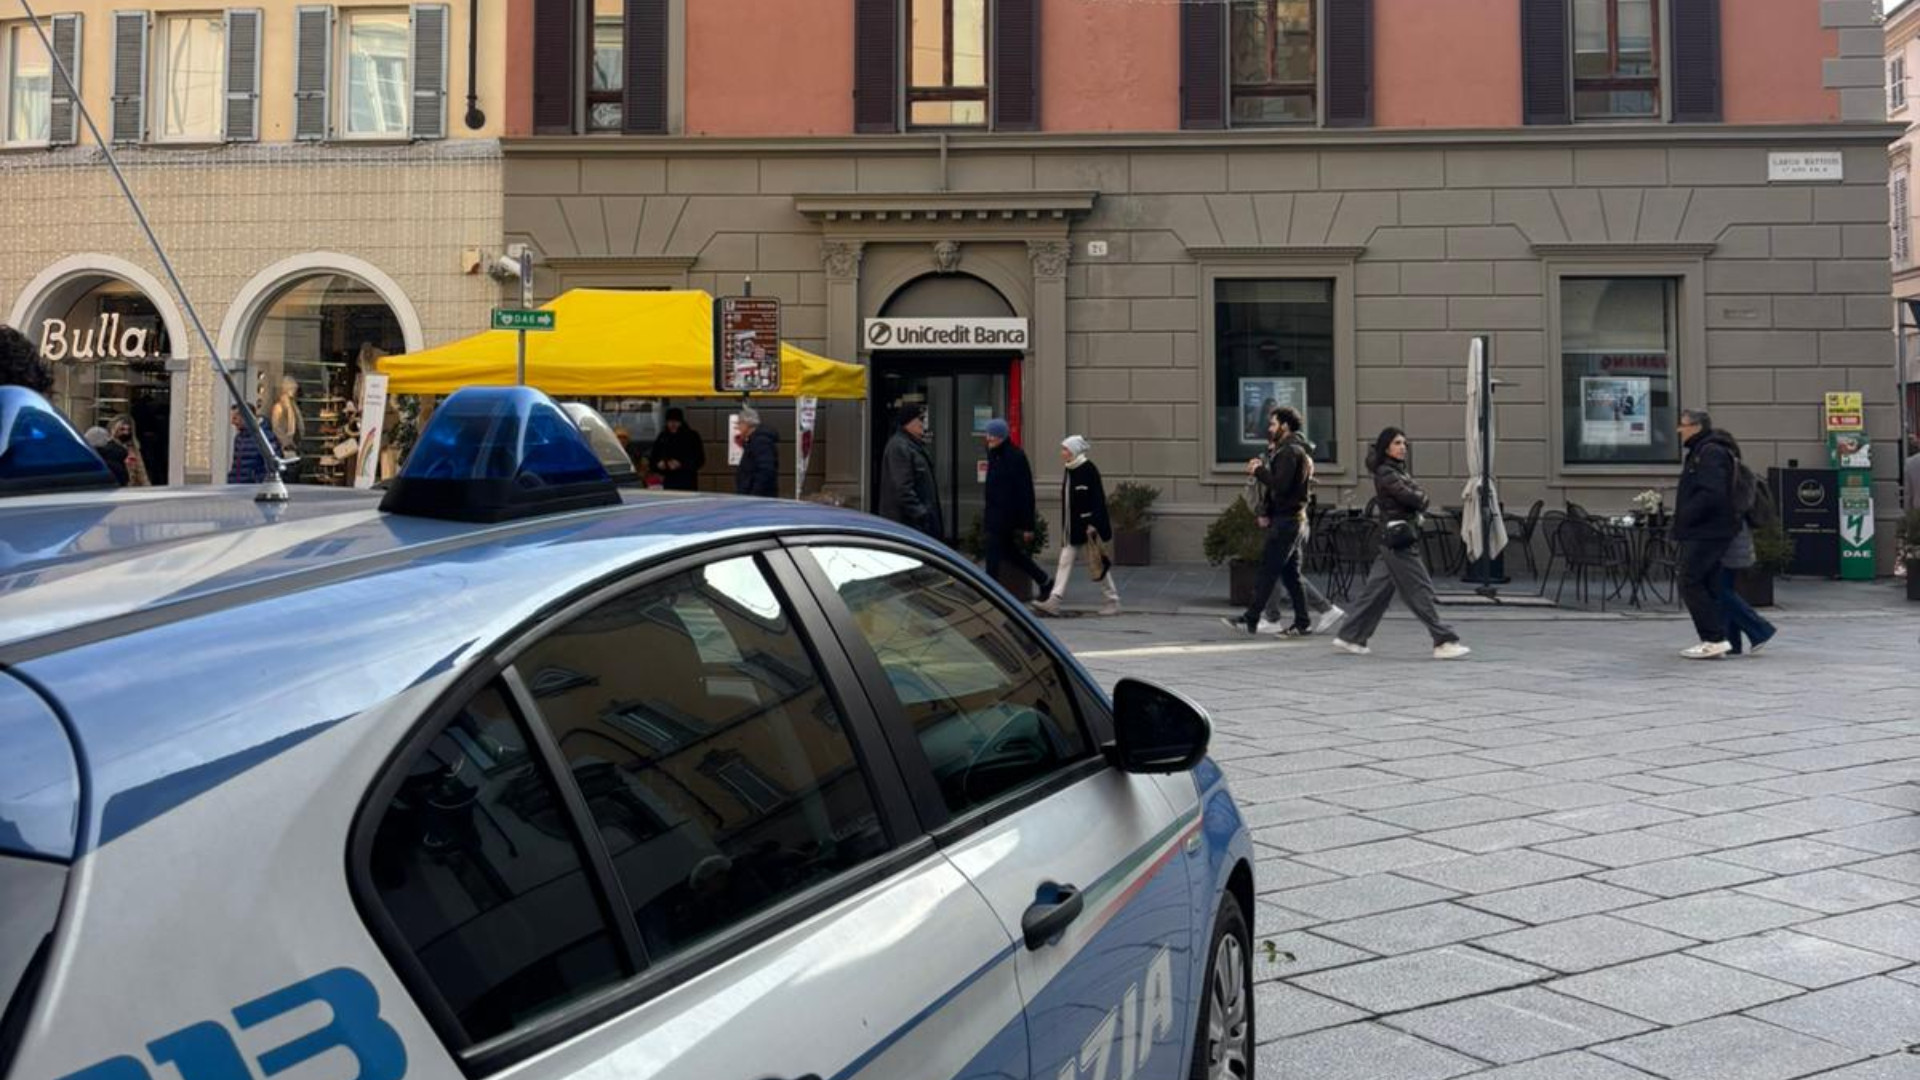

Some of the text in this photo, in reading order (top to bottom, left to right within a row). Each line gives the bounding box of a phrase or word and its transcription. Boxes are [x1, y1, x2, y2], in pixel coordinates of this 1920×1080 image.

[897, 325, 1025, 344] UniCredit Banca
[1842, 549, 1872, 558] DAE
